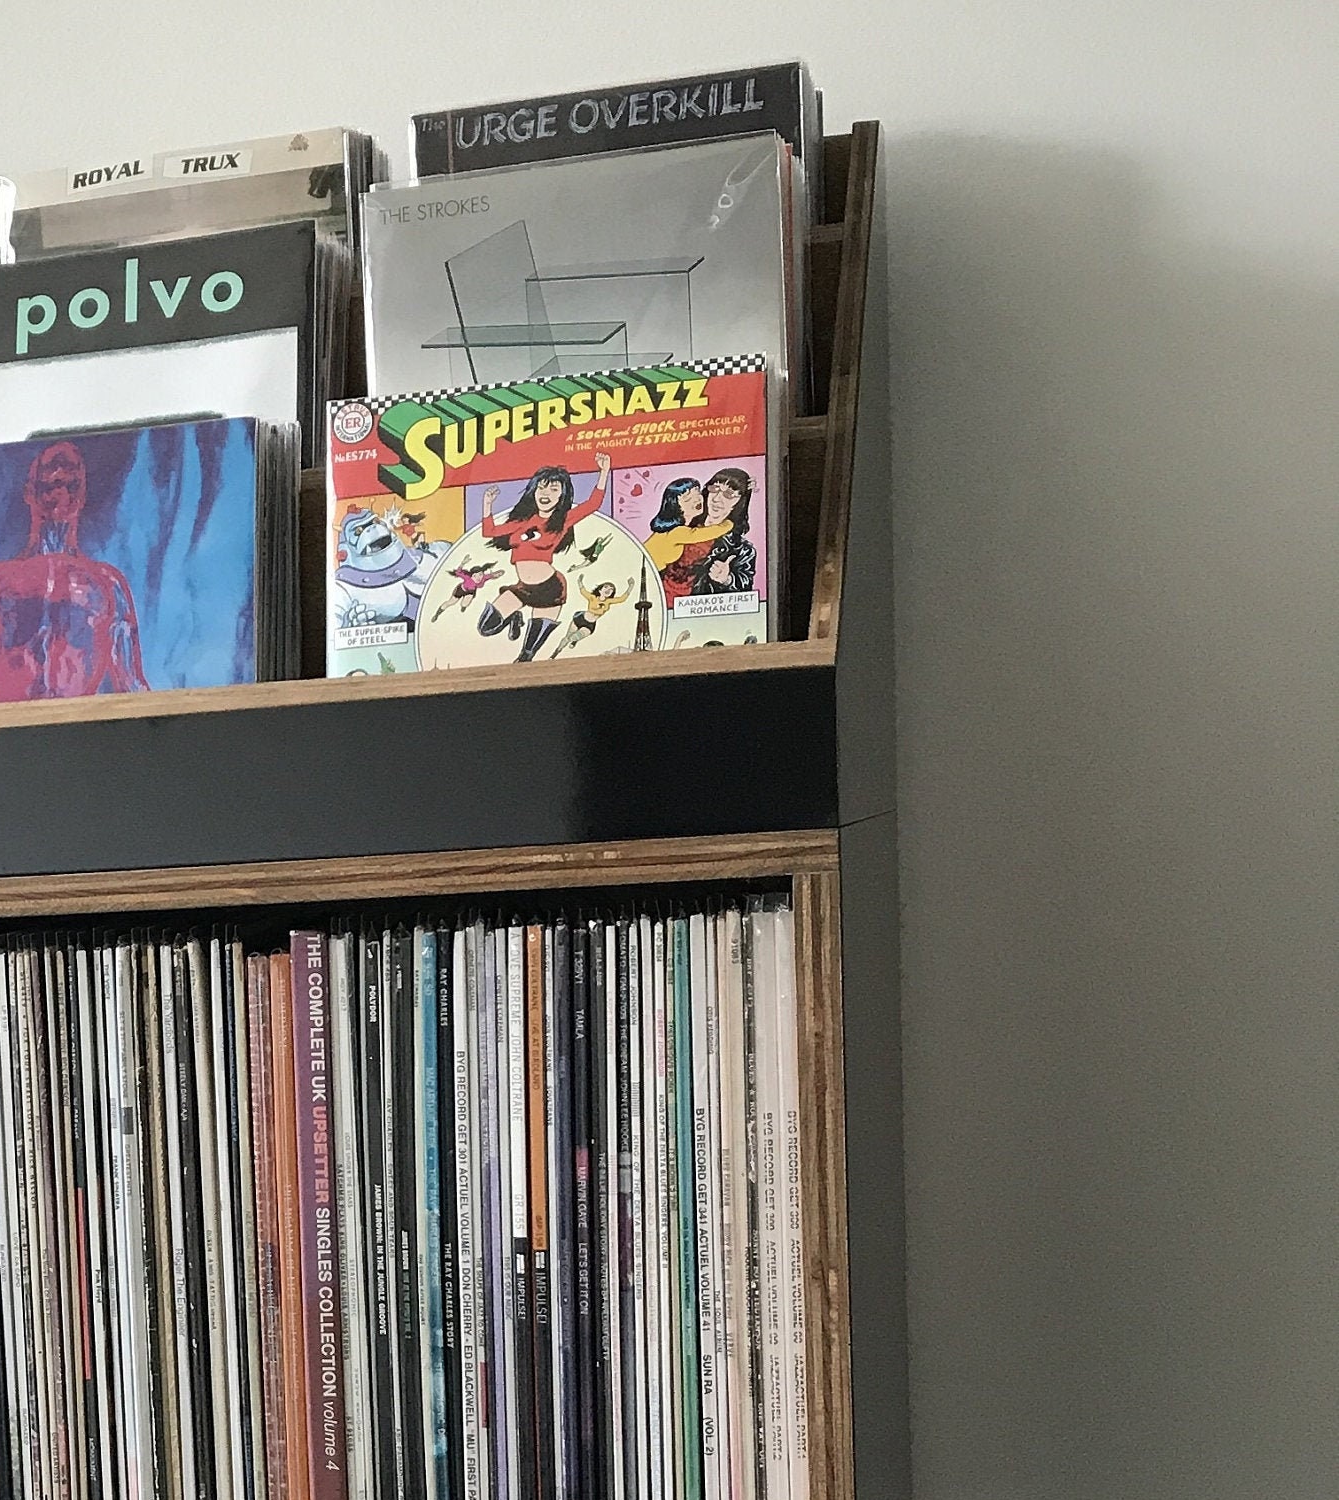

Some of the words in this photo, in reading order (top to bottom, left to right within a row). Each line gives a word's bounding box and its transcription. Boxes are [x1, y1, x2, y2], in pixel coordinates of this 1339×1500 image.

[455, 104, 558, 149] URGE
[569, 78, 764, 134] OVERKILL
[73, 160, 144, 189] ROYAL
[181, 152, 241, 174] TRUX
[380, 208, 410, 225] THE
[417, 196, 490, 221] STROKES
[16, 258, 244, 354] polvo
[345, 416, 361, 428] ER
[577, 427, 611, 440] SOCK
[631, 420, 676, 435] SHOCK
[679, 415, 745, 429] SPECTACULAR
[401, 374, 710, 501] SUPERSNAZZ
[565, 444, 573, 452] IN
[575, 442, 593, 451] THE
[596, 437, 633, 449] MIGHTY
[635, 431, 689, 447] ESTRUS
[690, 603, 739, 614] ROMANCE
[728, 594, 755, 605] FIRST
[338, 630, 353, 638] THE
[347, 637, 358, 645] OF
[359, 634, 387, 645] STEEL
[305, 935, 321, 967] THE
[438, 968, 448, 987] RAY
[162, 993, 171, 1010] The
[438, 990, 449, 1026] CHARLES
[162, 1013, 173, 1054] Yardbirds
[305, 972, 326, 1071] COMPLETE
[574, 1009, 585, 1038] TAMLA
[455, 1051, 466, 1072] BYG
[310, 1076, 326, 1101] UK
[455, 1076, 468, 1120] RECORD
[694, 1108, 705, 1131] BYG
[456, 1124, 468, 1145] GET
[310, 1106, 330, 1203] UPSETTER
[457, 1147, 468, 1164] 301
[695, 1134, 706, 1180] RECORD
[457, 1167, 470, 1208] ACTUEL
[576, 1167, 587, 1200] MARVIN
[697, 1183, 707, 1205] GET
[577, 1203, 587, 1227] GAYE
[697, 1208, 708, 1225] 341
[314, 1208, 332, 1281] SINGLES
[458, 1212, 471, 1255] VOLUME
[173, 1248, 184, 1275] Roger
[443, 1243, 451, 1260] THE
[578, 1242, 588, 1267] LET'S
[698, 1229, 709, 1269] ACTUEL
[443, 1263, 452, 1278] RAY
[461, 1267, 472, 1289] DON
[578, 1270, 588, 1287] GET
[175, 1278, 185, 1294] The
[533, 1272, 548, 1323] IMPULSE!
[699, 1273, 711, 1317] VOLUME
[443, 1281, 453, 1319] CHARLES
[579, 1300, 589, 1314] ON
[175, 1297, 187, 1336] Engineer
[461, 1293, 473, 1336] CHERRY
[701, 1319, 710, 1331] 41
[317, 1286, 337, 1396] COLLECTION
[444, 1321, 454, 1347] STORY
[463, 1345, 474, 1358] ED
[702, 1354, 712, 1375] SUN
[462, 1362, 476, 1426] BLACKWELL
[703, 1378, 713, 1394] RA
[321, 1400, 339, 1457] volume
[703, 1446, 715, 1455] 2)
[325, 1460, 339, 1470] 4
[466, 1458, 477, 1486] FIRST
